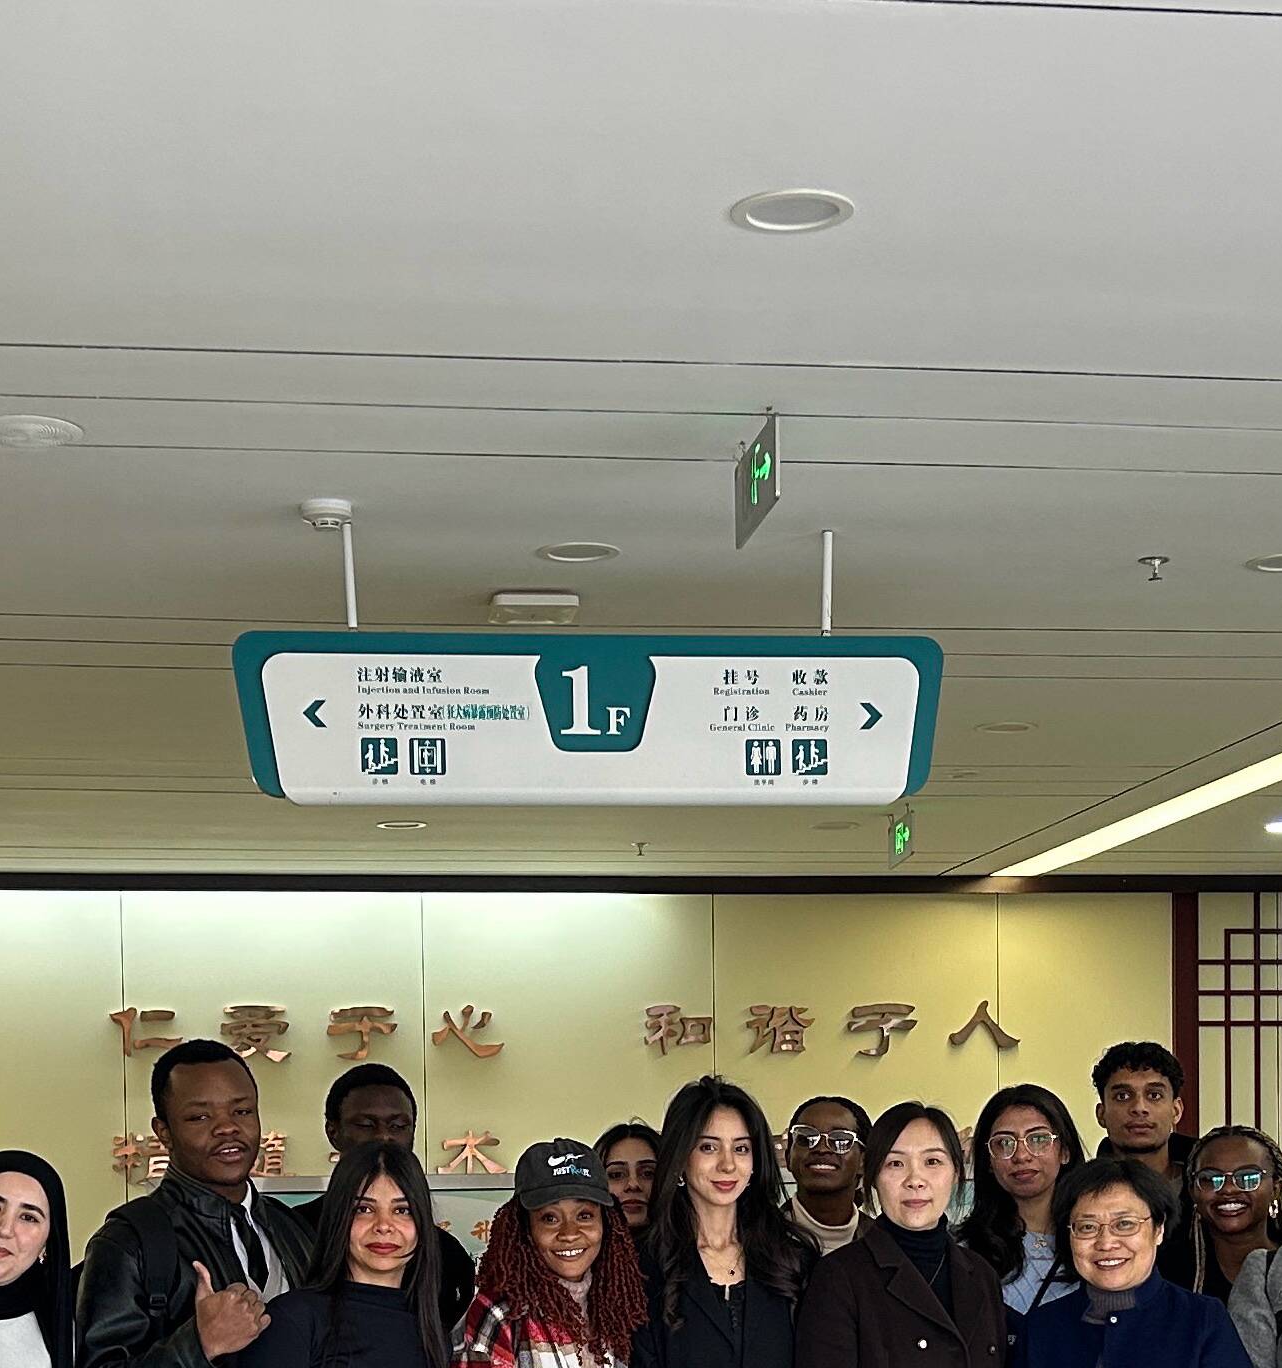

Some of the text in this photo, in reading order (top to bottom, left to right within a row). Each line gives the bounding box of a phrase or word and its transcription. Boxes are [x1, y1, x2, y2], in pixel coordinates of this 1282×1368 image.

[357, 666, 442, 683] 注射输液室
[723, 669, 829, 685] 挂号 收款
[357, 685, 490, 695] Injection and Infusion Room
[713, 687, 828, 697] Registration Cashier
[559, 663, 631, 737] 1F
[723, 705, 829, 722] 门诊 药房
[357, 722, 476, 732] Surgery Treatment Room
[709, 723, 830, 733] General Clinic Pharmacy
